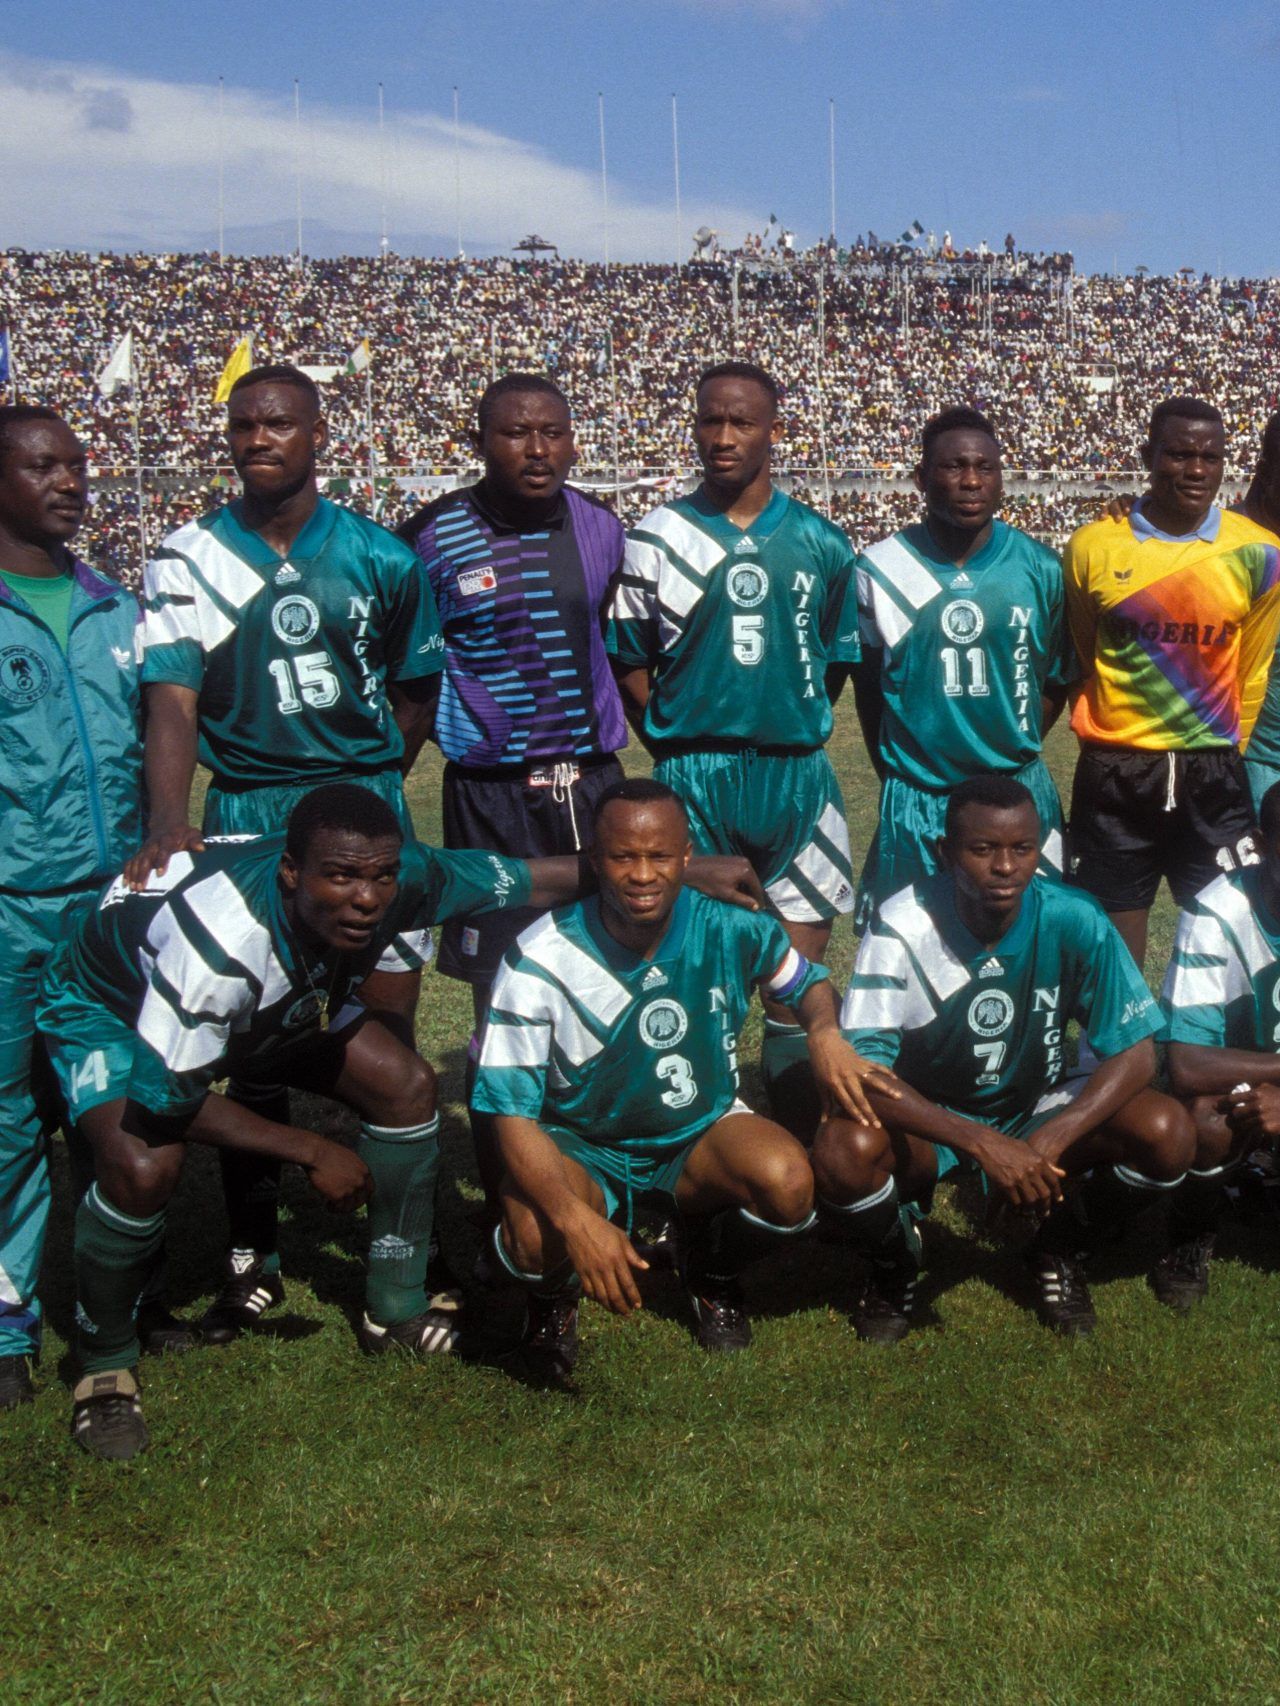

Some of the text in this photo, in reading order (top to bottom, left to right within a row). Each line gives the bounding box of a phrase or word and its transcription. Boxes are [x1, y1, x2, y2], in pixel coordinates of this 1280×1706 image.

[459, 568, 491, 582] PENALTY
[732, 615, 765, 665] 5
[791, 571, 816, 698] NIGERIA
[268, 651, 341, 715] 15
[941, 648, 990, 696] 11
[1008, 605, 1033, 733] NIGERIA
[1033, 984, 1061, 1085] NIGER
[71, 1050, 109, 1105] 14
[656, 1054, 698, 1109] 3
[973, 1041, 1007, 1085] 7
